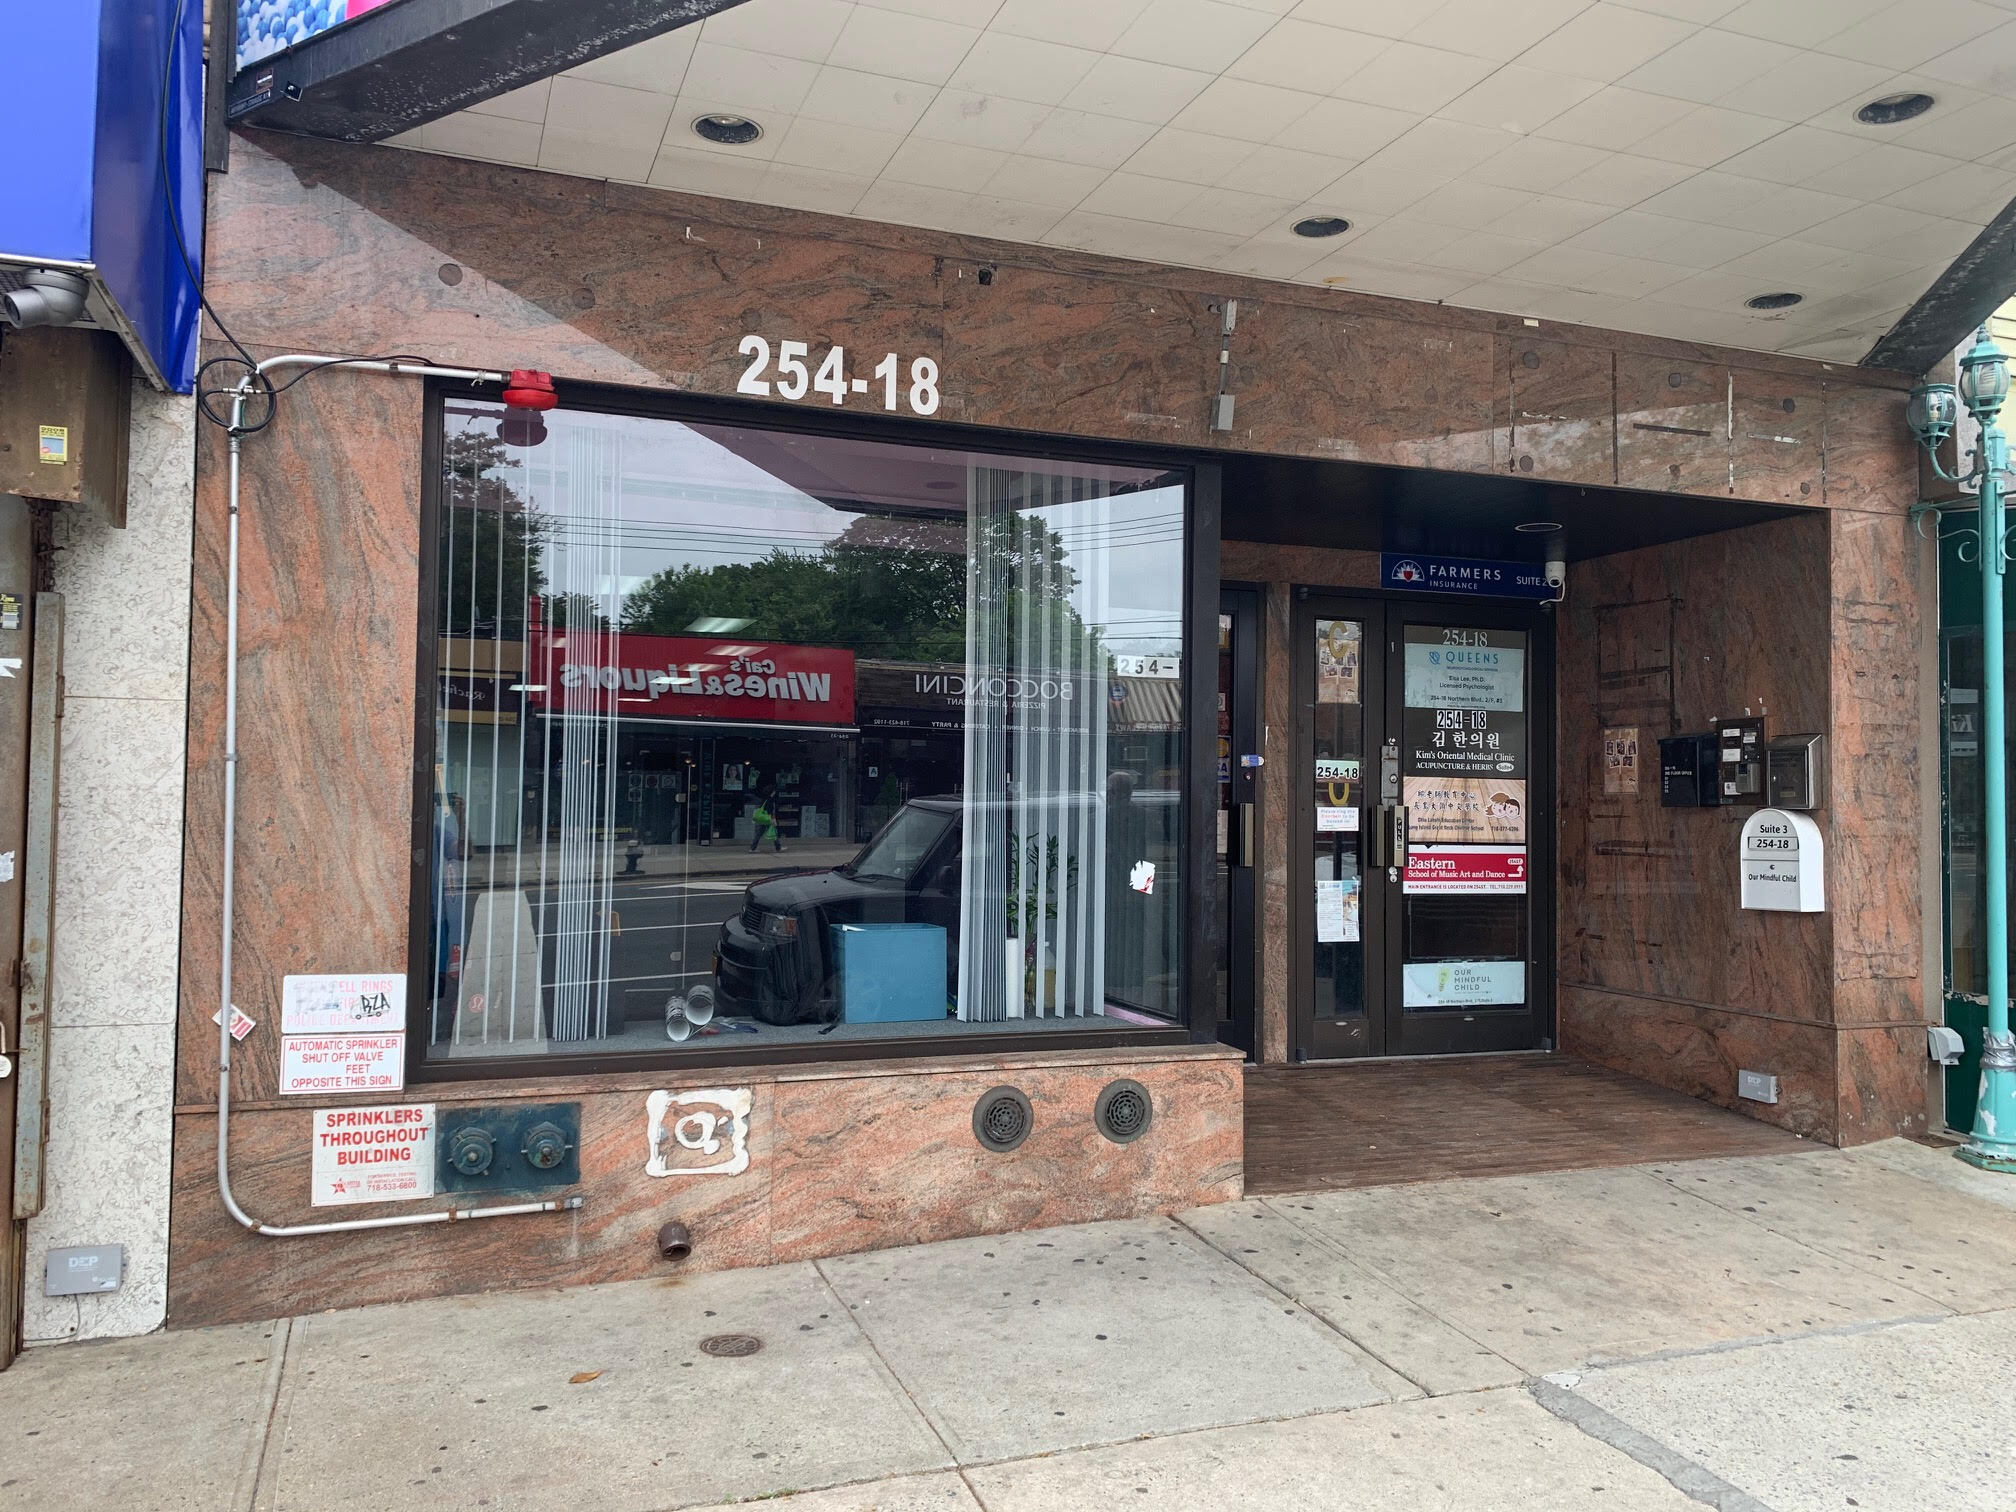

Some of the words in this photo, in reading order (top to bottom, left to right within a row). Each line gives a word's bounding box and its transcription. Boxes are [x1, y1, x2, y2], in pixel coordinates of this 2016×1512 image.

[736, 334, 940, 416] 254-18
[1429, 565, 1501, 581] FARMERS
[1429, 580, 1478, 590] INSURANCE
[1516, 575, 1541, 586] SUITE
[1442, 629, 1488, 647] 254-18
[1445, 651, 1499, 664] QUEENS
[1432, 730, 1446, 747] 김
[1452, 730, 1500, 749] 한의원
[1415, 750, 1436, 760] Kim's
[1437, 751, 1466, 760] Oriental
[1466, 751, 1494, 761] Medical
[1494, 752, 1515, 762] Clinic
[1316, 766, 1359, 779] 254-18
[1415, 762, 1465, 770] ACUPUNCTURE
[1472, 763, 1494, 771] HERBS
[1759, 825, 1781, 834] Suite
[1782, 825, 1788, 834] 3
[1756, 839, 1789, 849] 254-18
[1408, 857, 1457, 870] Eastern
[1408, 870, 1430, 878] School
[1430, 870, 1439, 878] of
[1759, 873, 1781, 882] Mindful
[1782, 874, 1797, 883] Child
[361, 980, 393, 993] RINGS
[289, 1040, 345, 1051] AUTOMATIC
[346, 1039, 398, 1050] SPRINKLER
[302, 1053, 328, 1064] SHUT
[331, 1053, 351, 1062] OFF
[354, 1051, 384, 1062] VALVE
[346, 1064, 371, 1074] FEET
[291, 1077, 342, 1088] OPPOSITE
[346, 1076, 366, 1086] THIS
[369, 1075, 392, 1086] SIGN
[326, 1108, 424, 1128] SPRINKLERS
[319, 1127, 429, 1148] THROUGHOUT
[337, 1147, 411, 1166] BUILDING
[68, 1256, 98, 1268] DEP
